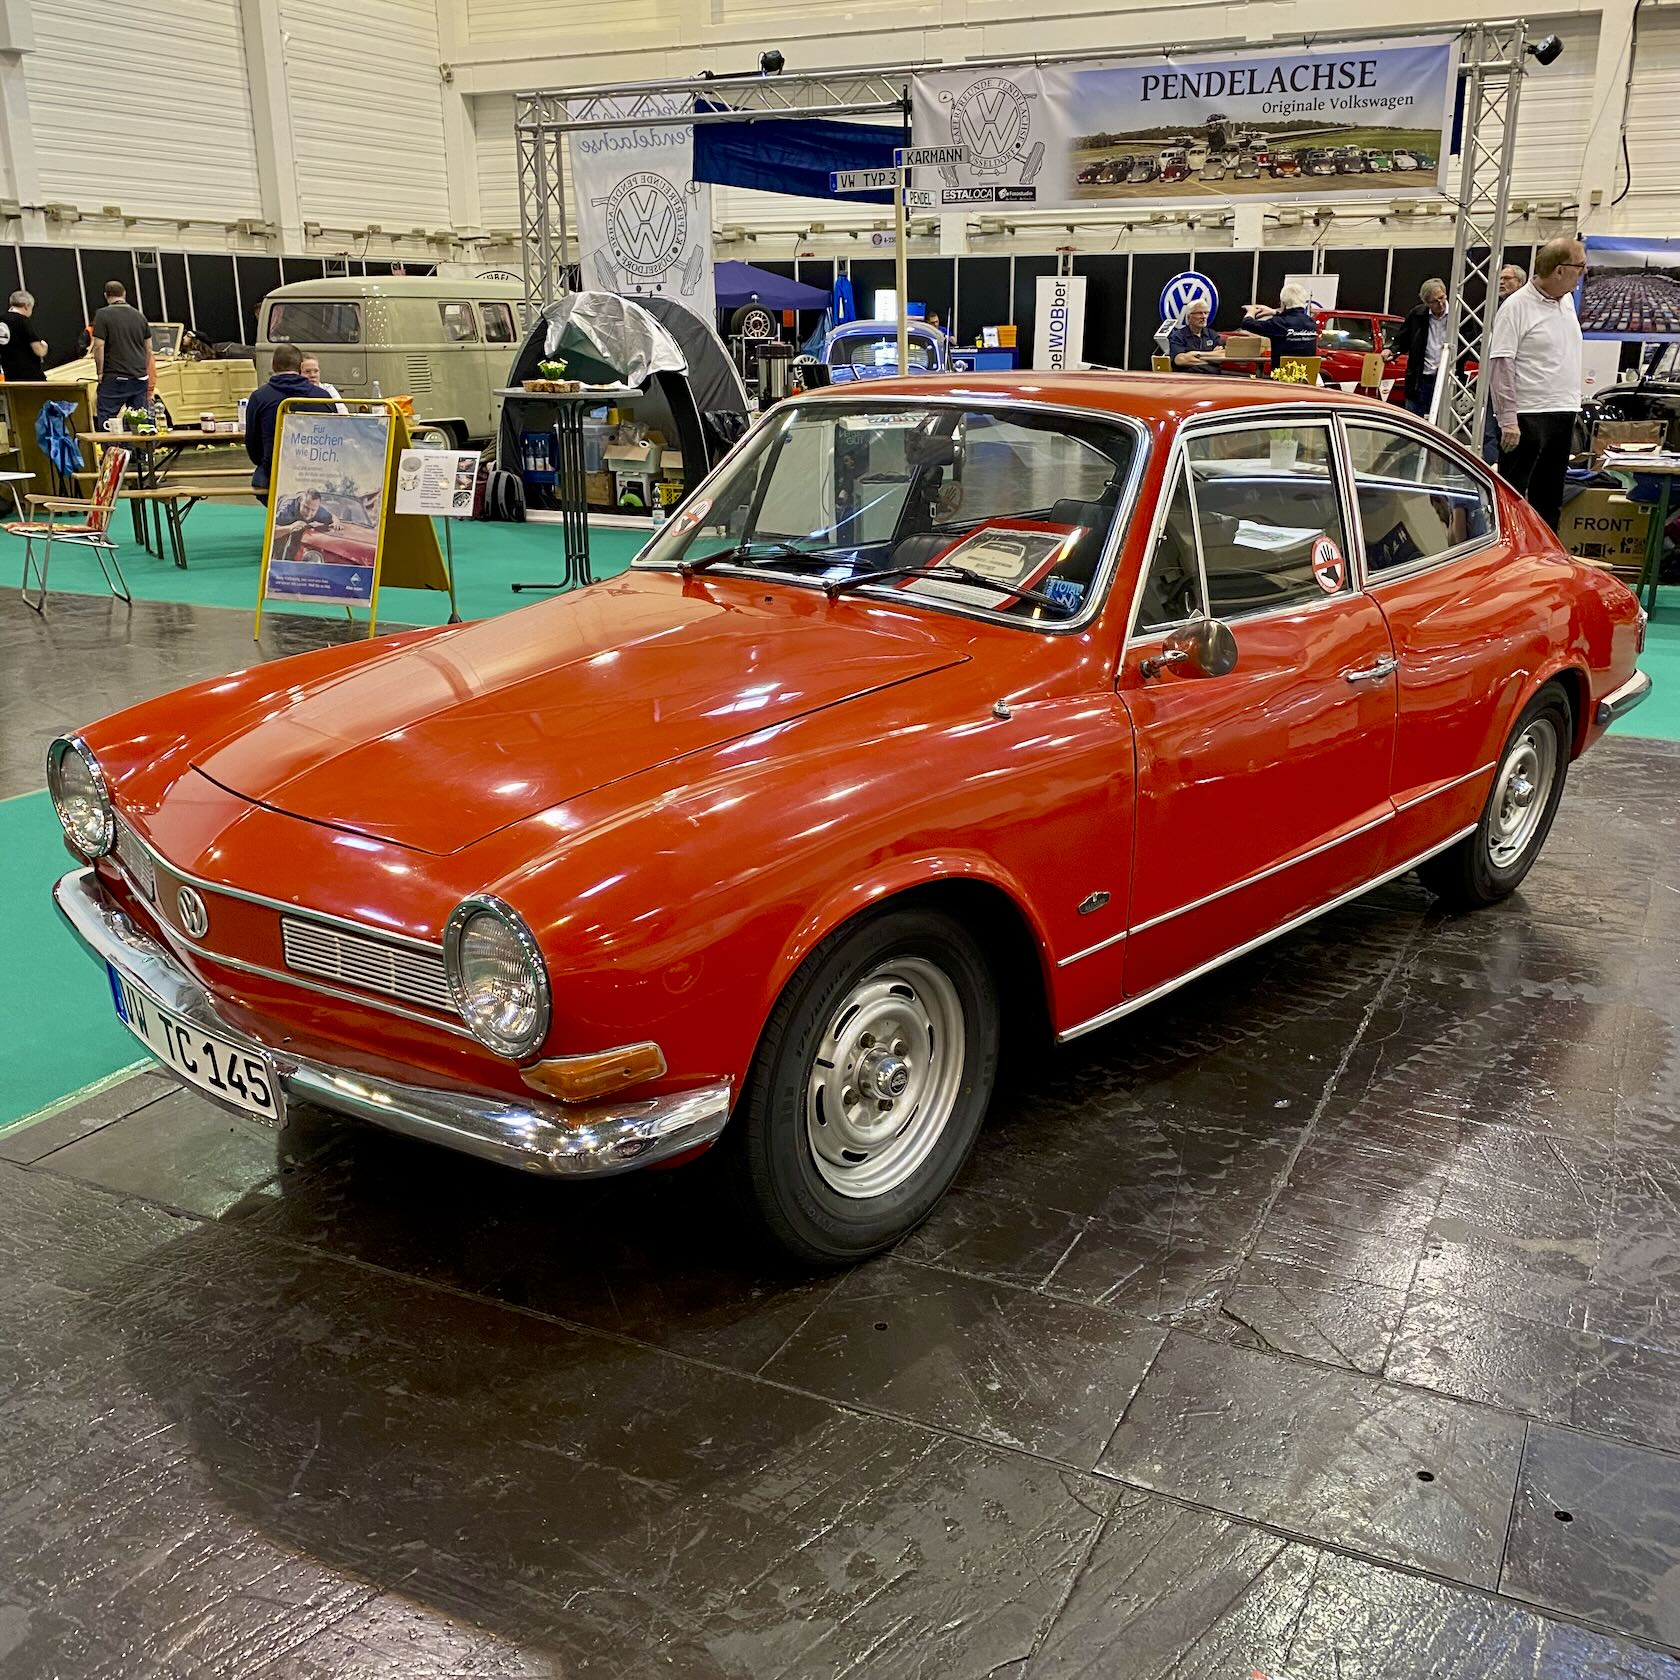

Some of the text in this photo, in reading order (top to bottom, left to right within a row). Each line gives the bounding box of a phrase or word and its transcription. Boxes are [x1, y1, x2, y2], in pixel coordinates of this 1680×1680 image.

[1140, 60, 1378, 101] PENDELACHSE
[1262, 94, 1415, 116] Originale Volkswagen
[906, 148, 963, 166] KARMANN
[971, 148, 1016, 168] SSELDORF
[841, 171, 897, 188] VW TYP 3
[909, 191, 932, 206] PENDEL
[943, 188, 993, 200] ESTALOCA
[290, 432, 344, 446] Menschen
[295, 447, 340, 463] wie Dich.
[1573, 517, 1635, 532] FRONT
[1054, 582, 1081, 596] TOTAL
